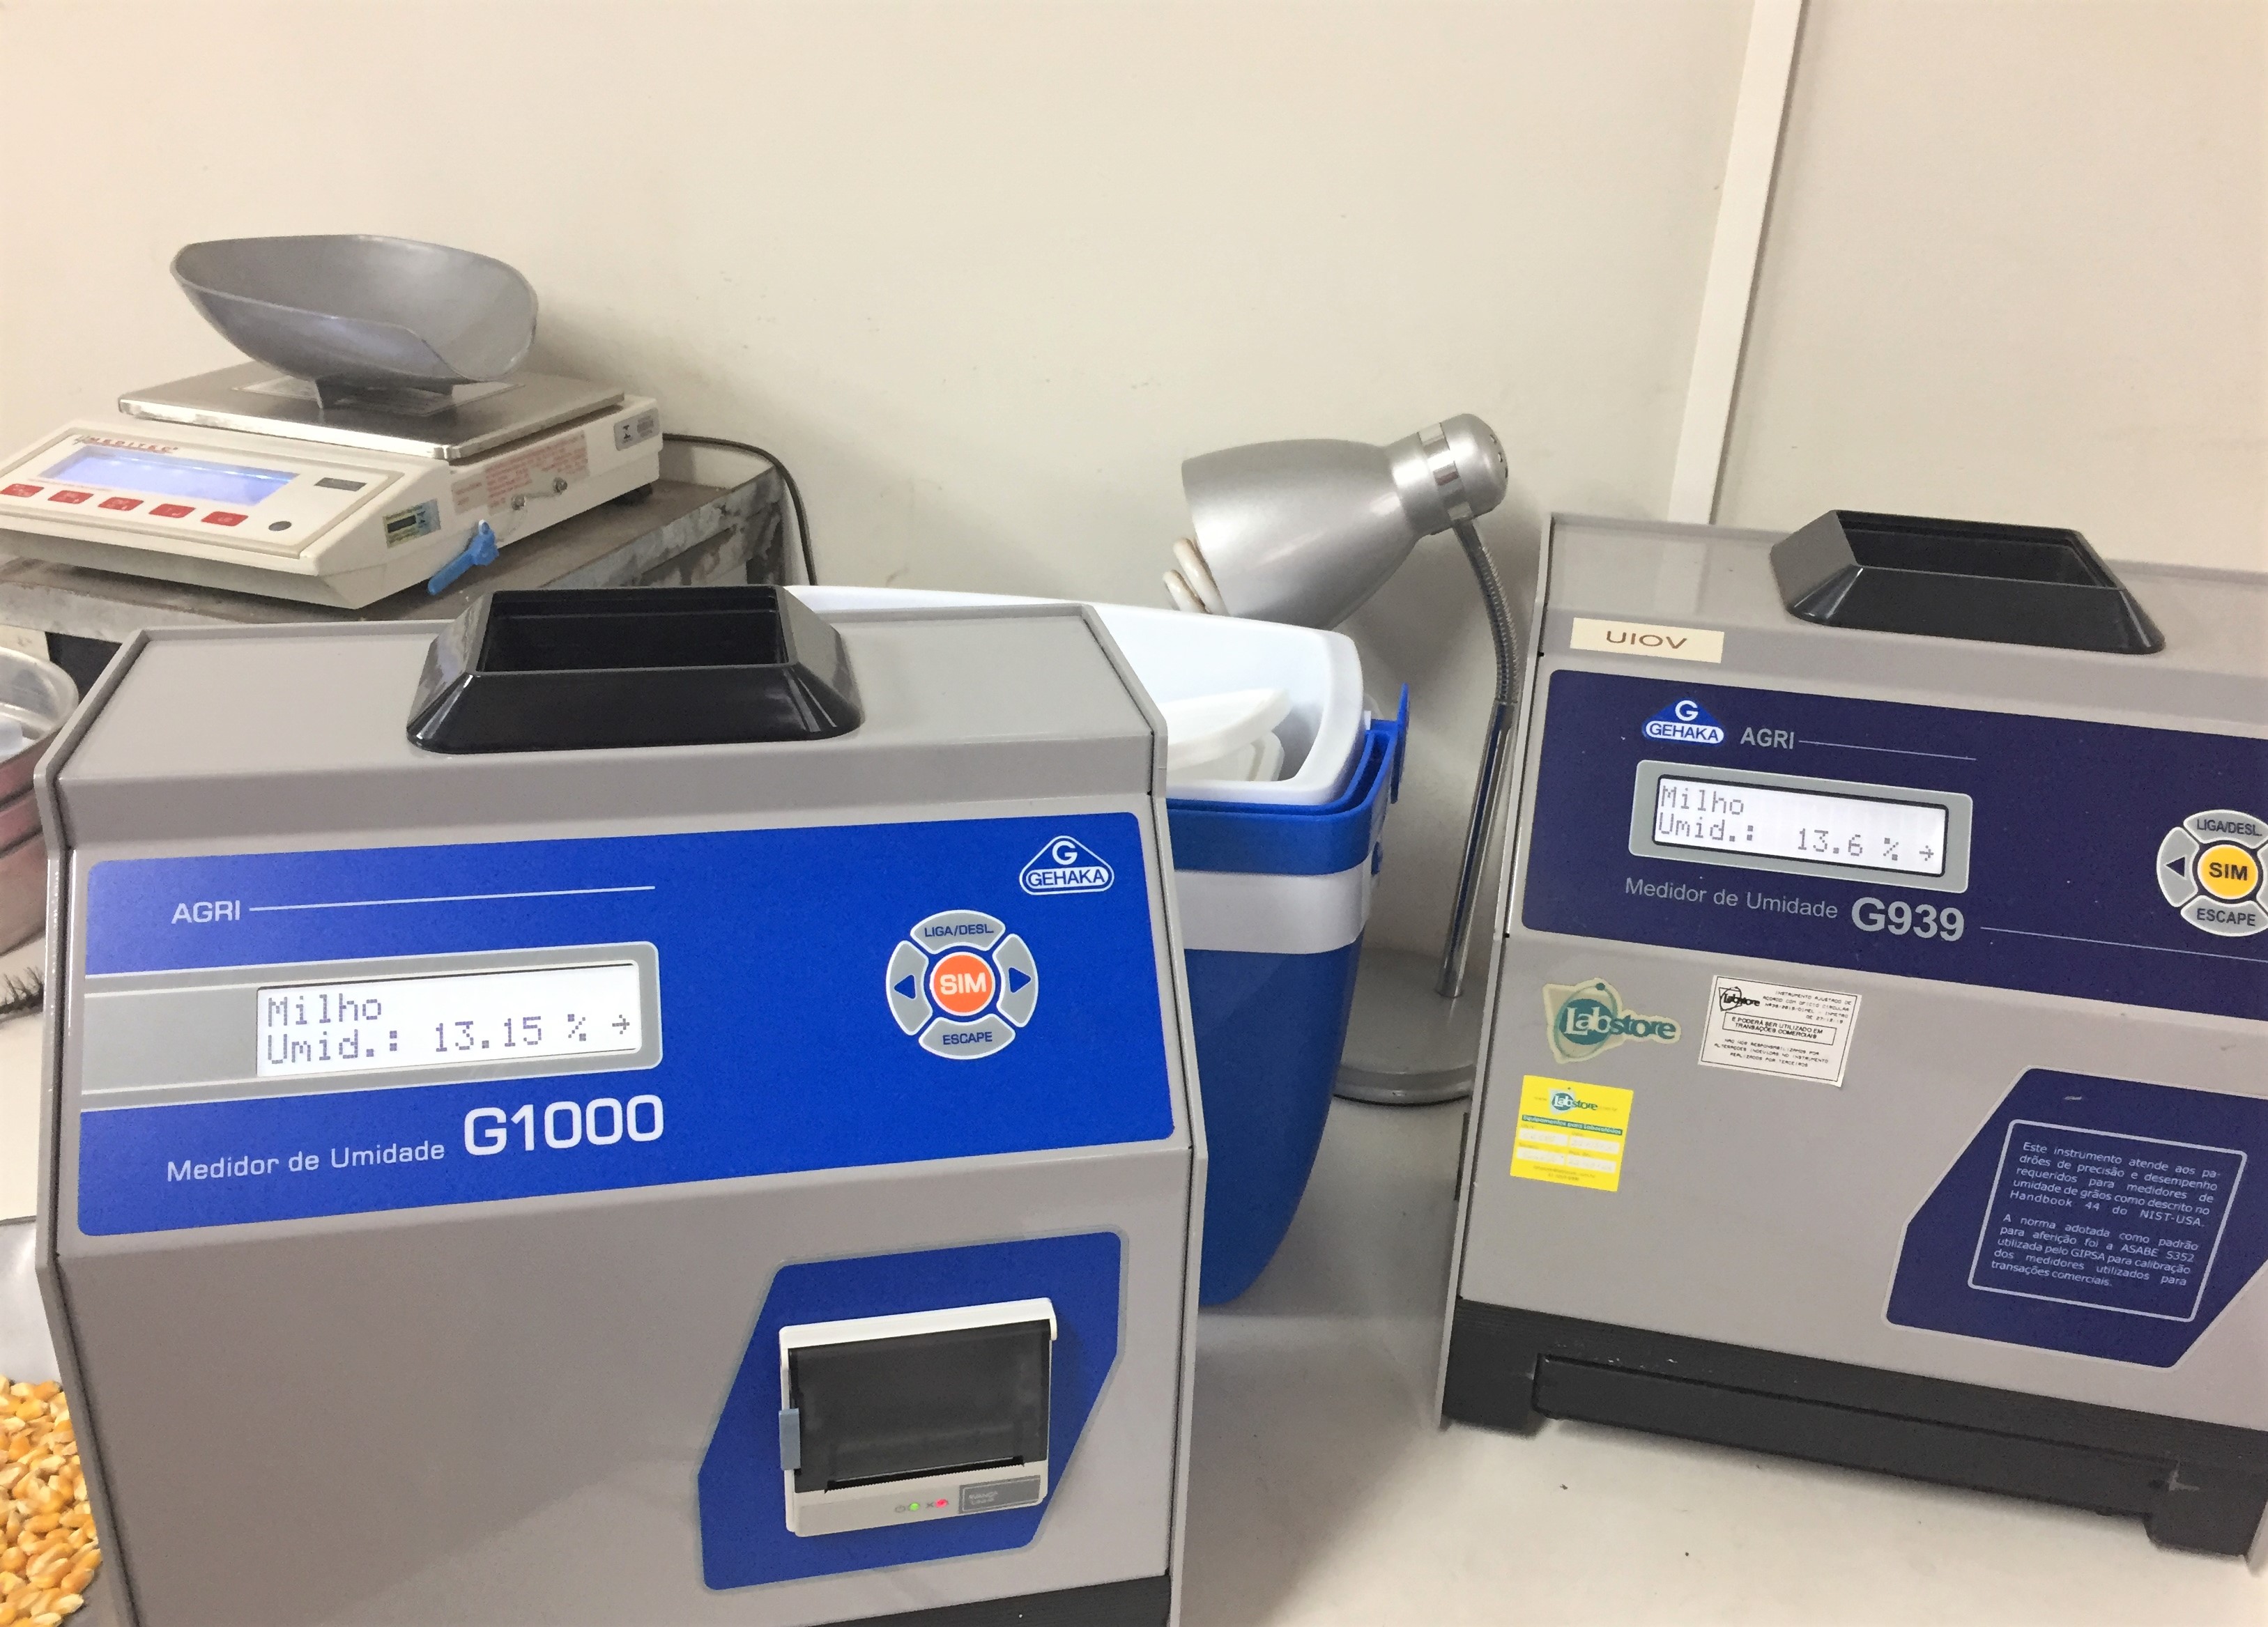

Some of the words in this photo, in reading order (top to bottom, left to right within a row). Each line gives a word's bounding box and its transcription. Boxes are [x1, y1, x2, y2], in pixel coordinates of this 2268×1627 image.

[1649, 723, 1719, 741] GEHAKA
[1740, 727, 1795, 749] AGRI
[1661, 785, 1744, 815] Milho
[1658, 813, 1754, 842] Umid.:
[1798, 828, 1862, 858] 13.6
[1028, 869, 1105, 886] GEHAKA
[2209, 863, 2248, 881] SIM
[171, 900, 240, 924] AGRI
[1625, 878, 1707, 904] Medidor
[1713, 890, 1738, 907] de
[1747, 893, 1838, 919] Umidade
[1851, 896, 1965, 941] G939
[2196, 908, 2256, 926] ESCAPE
[940, 973, 987, 996] SIM
[266, 994, 382, 1026] Milho
[1563, 1007, 1676, 1040] Labstore
[266, 1030, 398, 1065] Umid.:
[436, 1016, 542, 1052] 13.15
[942, 1032, 993, 1045] ESCAPE
[1778, 1028, 1817, 1039] COMERCIAIS
[1779, 1023, 1812, 1033] UTILIZADO
[1554, 1095, 1597, 1110] Labstore
[167, 1156, 279, 1182] Medidor
[289, 1151, 319, 1172] de
[331, 1141, 445, 1168] Umidade
[463, 1095, 664, 1156] G1000
[2019, 1155, 2051, 1166] drões
[2058, 1161, 2071, 1169] de
[2077, 1164, 2124, 1178] precisão
[2144, 1172, 2217, 1192] desempenho
[2023, 1142, 2047, 1154] Este
[2054, 1148, 2122, 1164] instrumento
[2129, 1159, 2168, 1171] atende
[2175, 1166, 2196, 1175] aos
[2014, 1179, 2061, 1193] umidade
[2064, 1186, 2078, 1196] de
[2081, 1189, 2112, 1201] grãos
[2115, 1195, 2145, 1206] como
[2147, 1198, 2193, 1213] descrito
[2196, 1207, 2209, 1215] no
[2016, 1167, 2078, 1182] requeridos
[2089, 1178, 2115, 1189] para
[2127, 1182, 2187, 1199] medidores
[2199, 1193, 2214, 1203] de
[2010, 1191, 2072, 1208] Handbook
[2085, 1201, 2099, 1211] 44
[2113, 1205, 2127, 1215] do
[2000, 1227, 2025, 1238] para
[2032, 1231, 2076, 1246] aferição
[2085, 1238, 2098, 1248] foi
[2120, 1243, 2158, 1258] ASABE
[2166, 1250, 2194, 1263] S352
[2003, 1213, 2012, 1222] A
[2021, 1218, 2056, 1229] norma
[2065, 1224, 2110, 1238] adotada
[2119, 1232, 2150, 1243] como
[2159, 1237, 2198, 1251] padrão
[1994, 1249, 2014, 1259] dos
[2026, 1254, 2085, 1270] medidores
[2096, 1265, 2150, 1280] utilizados
[2161, 1276, 2186, 1286] para
[1998, 1238, 2043, 1252] utilizada
[2045, 1245, 2068, 1256] pelo
[2071, 1248, 2104, 1261] GIPSA
[2108, 1254, 2132, 1265] para
[2135, 1258, 2191, 1275] calibração
[1991, 1260, 2049, 1277] transações
[2051, 1269, 2112, 1287] comerciais.
